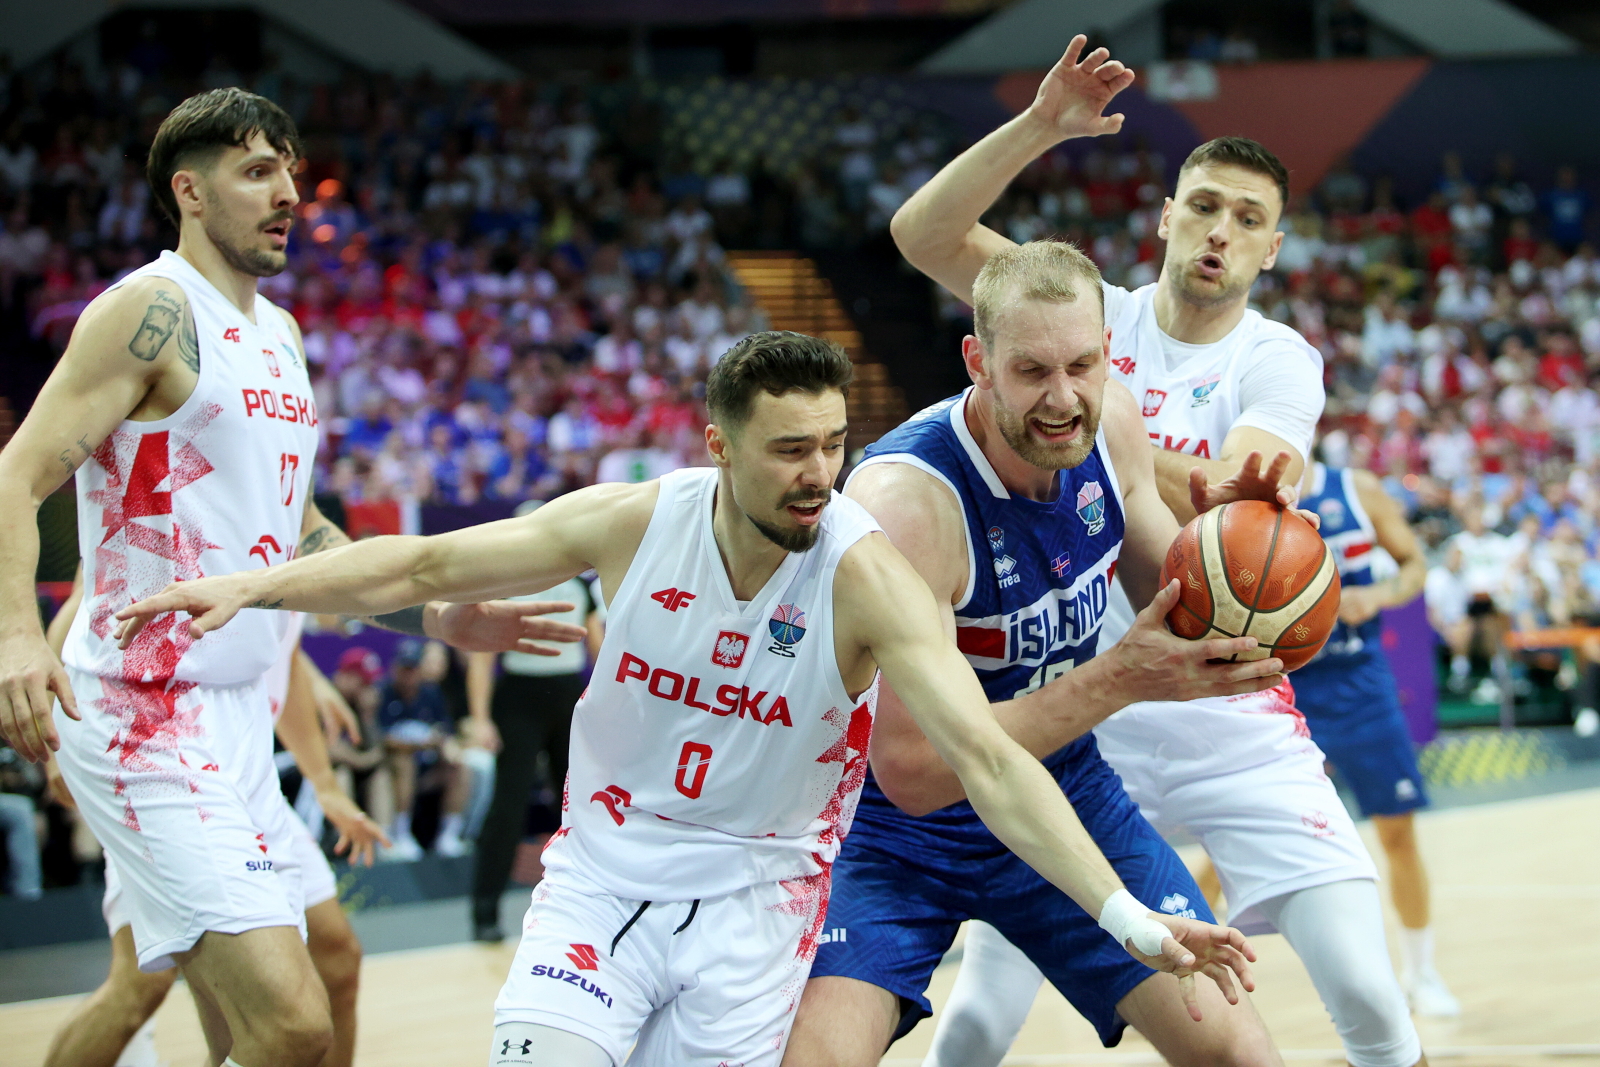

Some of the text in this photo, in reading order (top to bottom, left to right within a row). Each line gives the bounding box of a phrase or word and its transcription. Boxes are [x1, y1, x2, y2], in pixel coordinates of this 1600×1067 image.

[242, 388, 318, 427] POLSKA
[279, 452, 299, 506] 17
[998, 572, 1021, 589] rrea
[650, 587, 697, 613] 4F
[767, 641, 796, 658] 25
[614, 651, 794, 728] POLSKA
[674, 740, 713, 800] 0
[245, 860, 273, 871] SUZ
[817, 927, 847, 945] all
[530, 964, 613, 1009] SUZUKI
